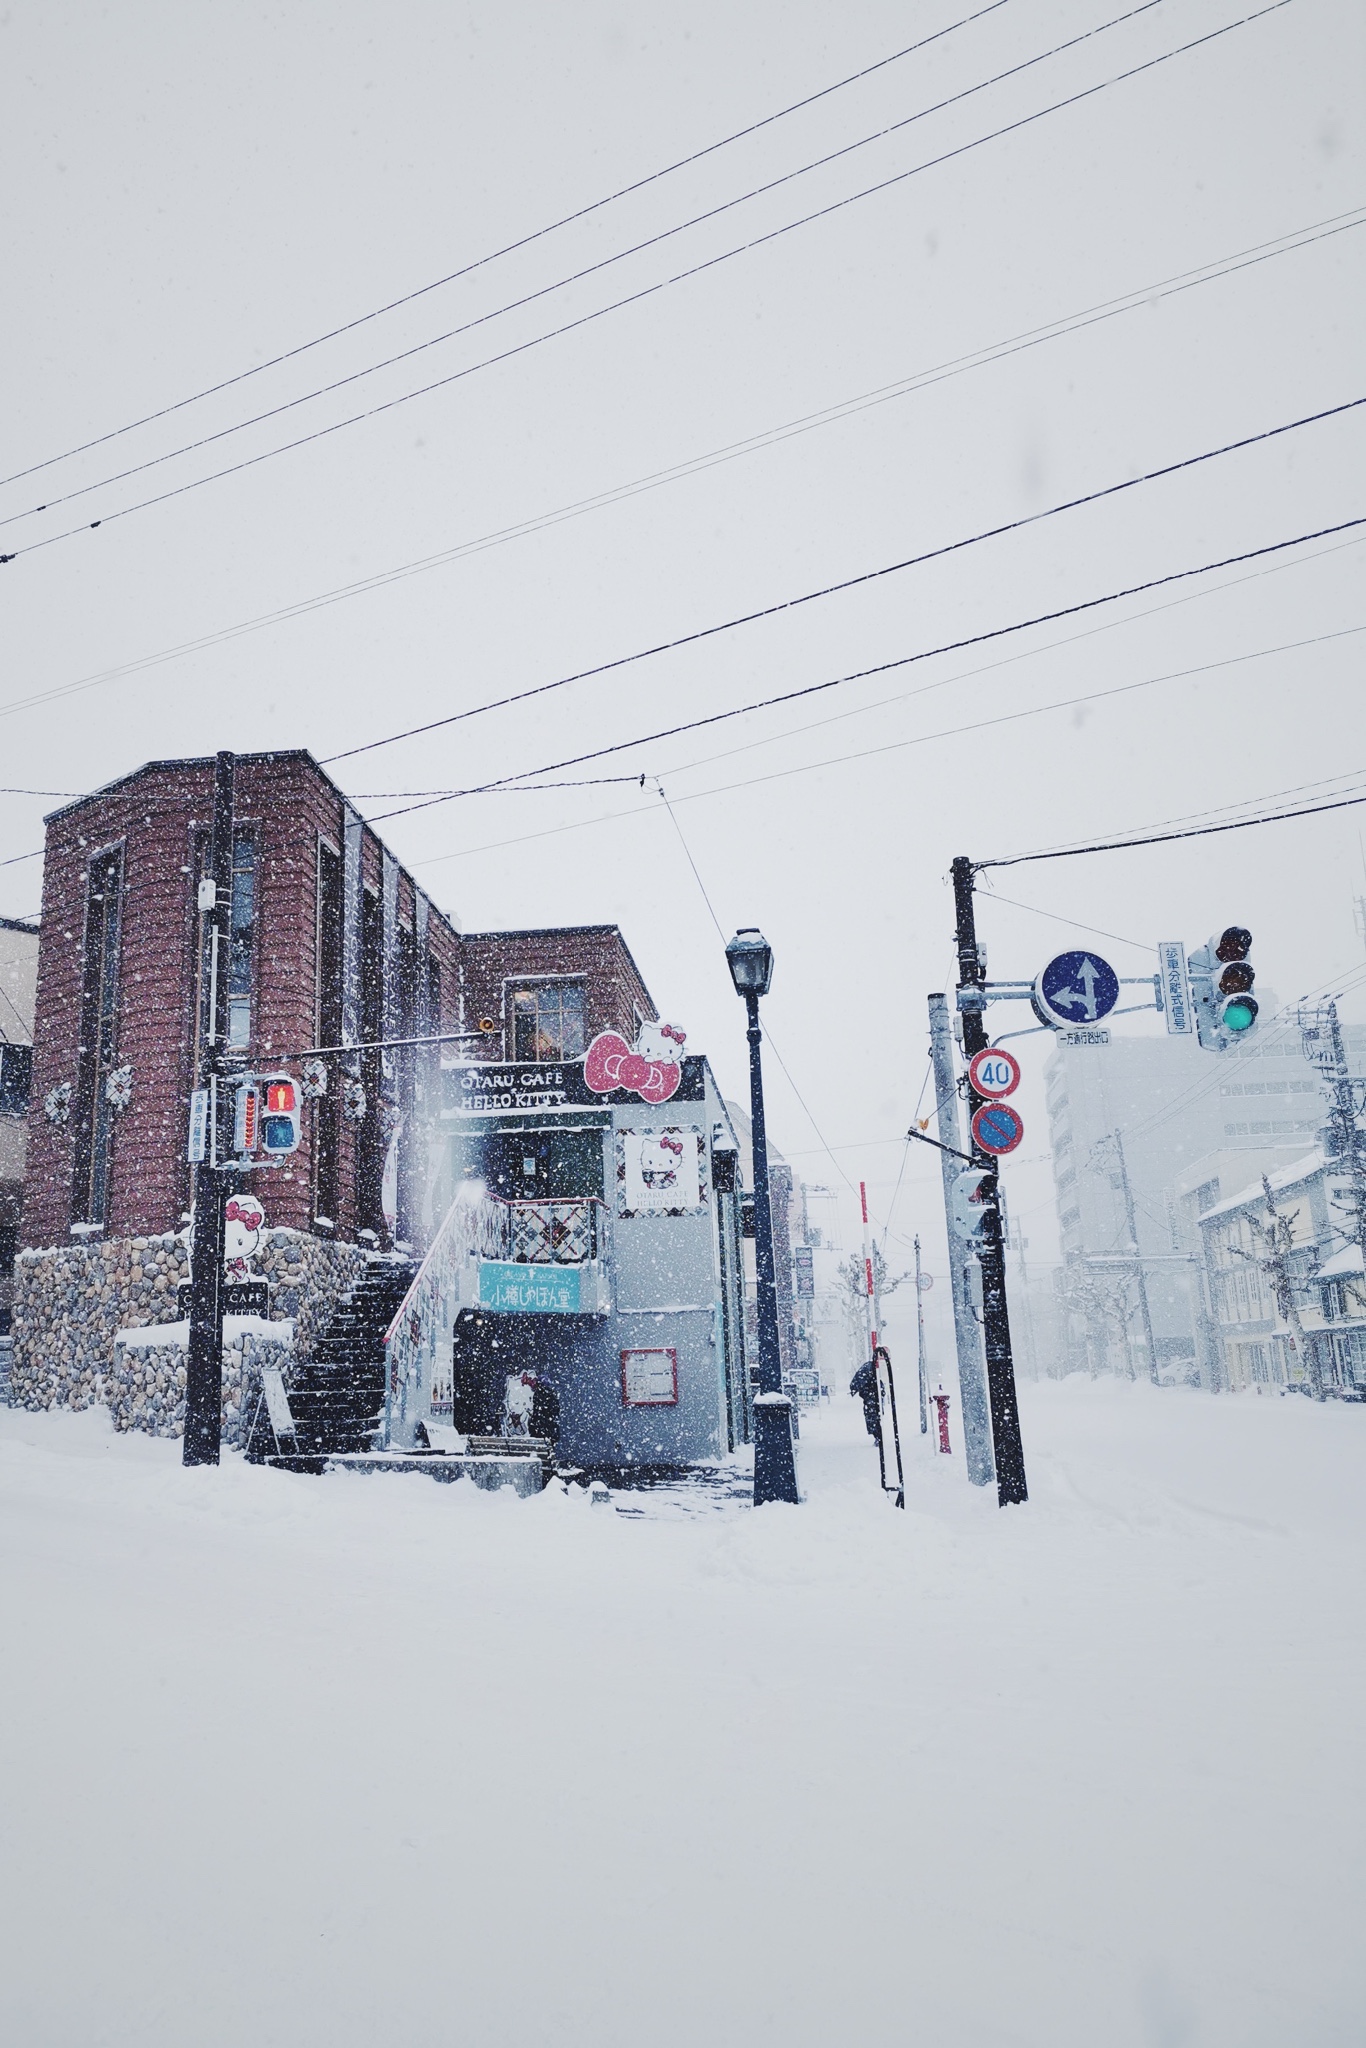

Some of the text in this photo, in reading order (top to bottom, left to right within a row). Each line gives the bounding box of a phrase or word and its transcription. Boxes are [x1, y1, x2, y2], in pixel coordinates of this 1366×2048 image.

[1165, 947, 1187, 1030] 歩車分離式信号
[461, 1072, 563, 1089] OTARU CAFE
[982, 1062, 1009, 1084] 40
[461, 1091, 566, 1110] HELLO KITTY
[636, 1190, 688, 1199] OTARU CAFE
[637, 1198, 688, 1207] HELLO KITTY
[229, 1292, 264, 1303] CAFE
